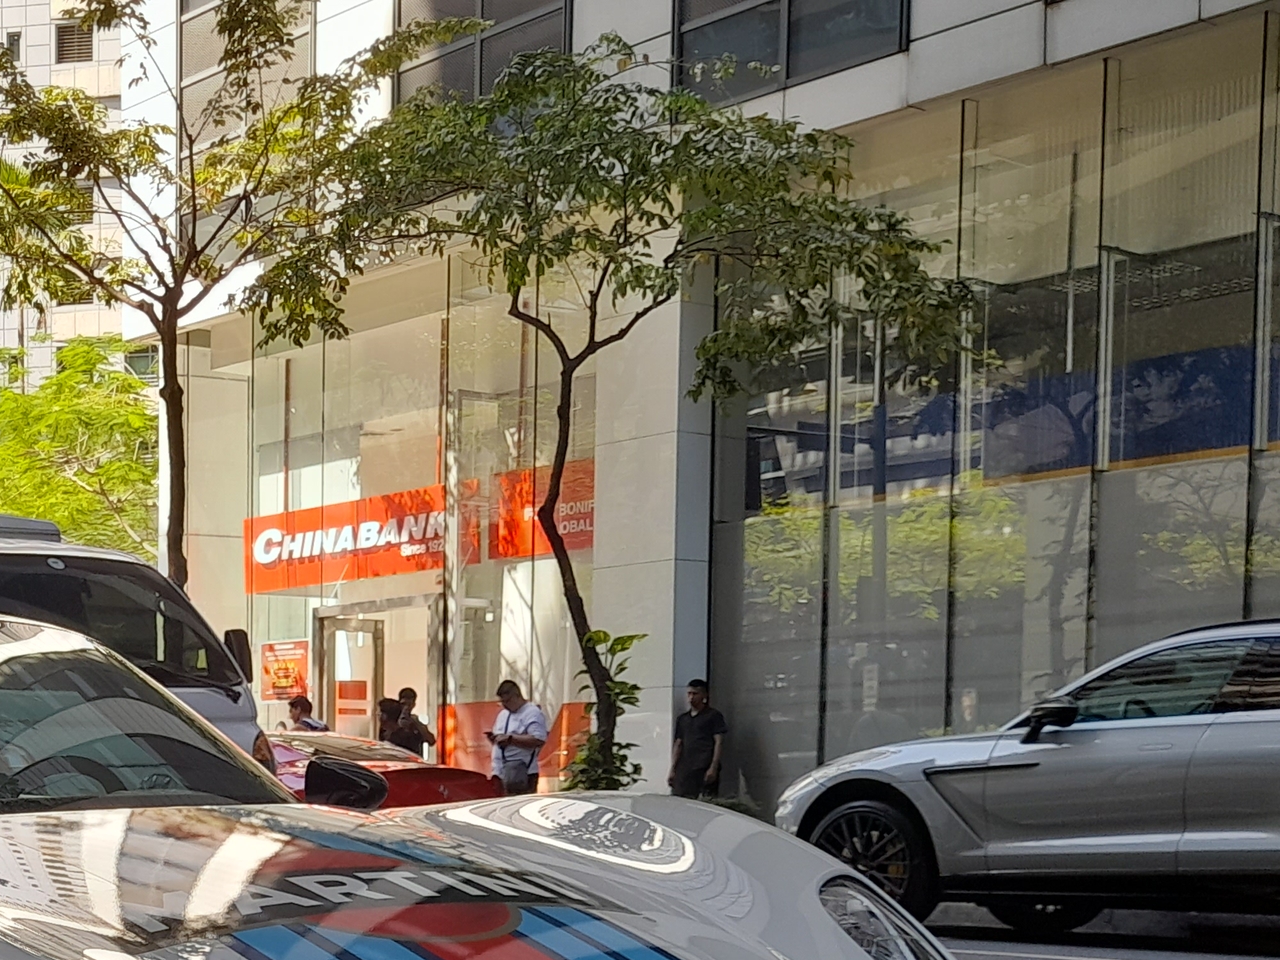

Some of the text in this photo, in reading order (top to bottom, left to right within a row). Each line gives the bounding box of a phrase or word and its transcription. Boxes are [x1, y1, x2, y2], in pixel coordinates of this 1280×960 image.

[559, 500, 595, 517] BONIF
[559, 518, 593, 535] OBAL
[400, 539, 444, 558] Since 192
